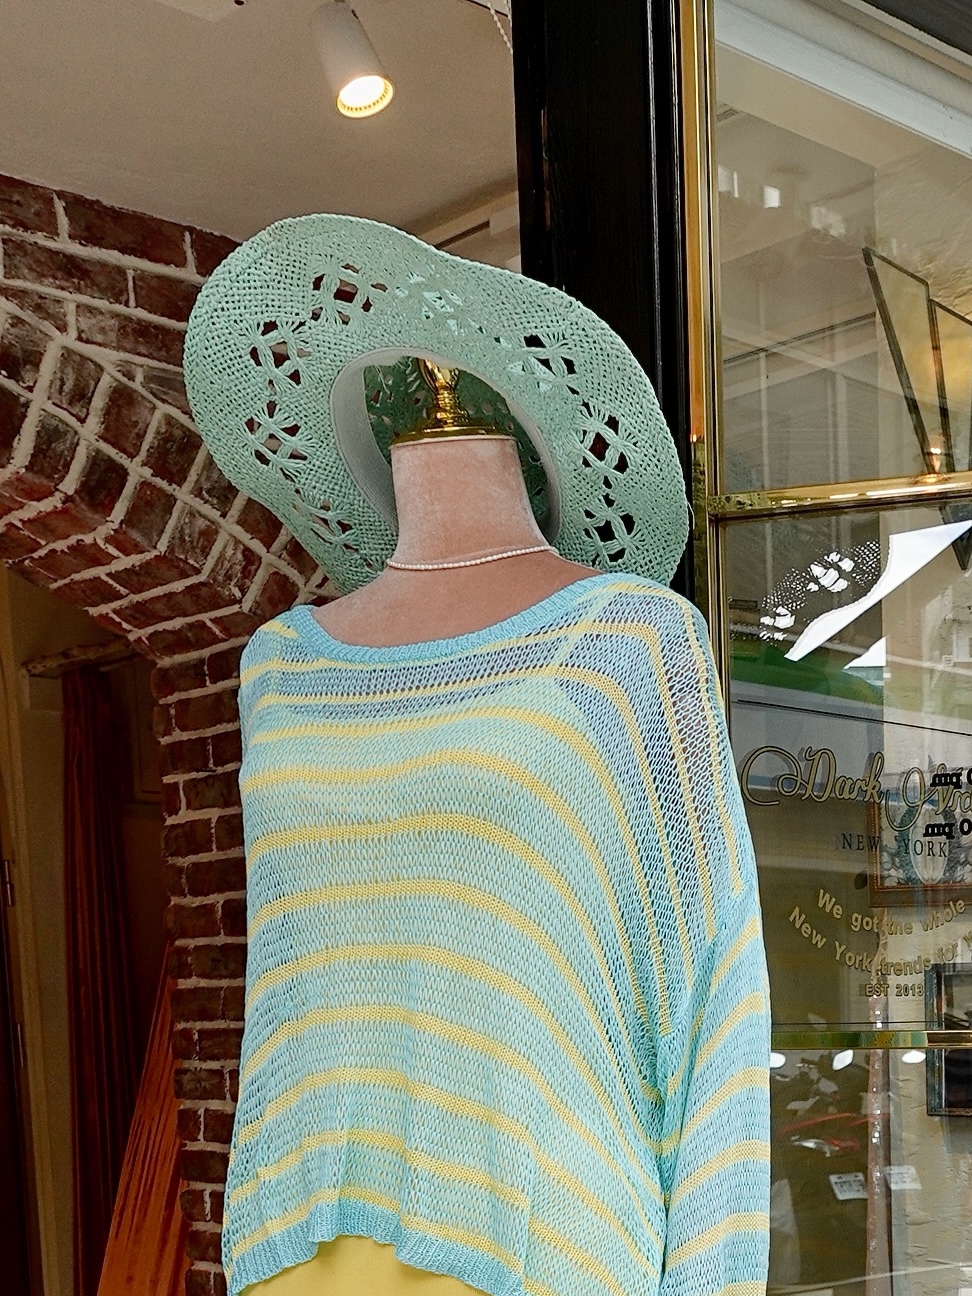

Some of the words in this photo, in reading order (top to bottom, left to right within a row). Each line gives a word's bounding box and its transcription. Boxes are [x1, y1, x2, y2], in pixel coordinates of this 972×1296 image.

[741, 745, 886, 807] Dark
[842, 833, 880, 851] NEW
[903, 838, 950, 858] YORK
[817, 888, 844, 919] We
[851, 912, 880, 933] got
[920, 899, 966, 932] whole
[788, 906, 828, 950] New
[834, 941, 875, 974] York
[880, 954, 932, 977] trends
[937, 941, 959, 966] for
[865, 983, 890, 998] EST
[895, 983, 925, 998] 2013
